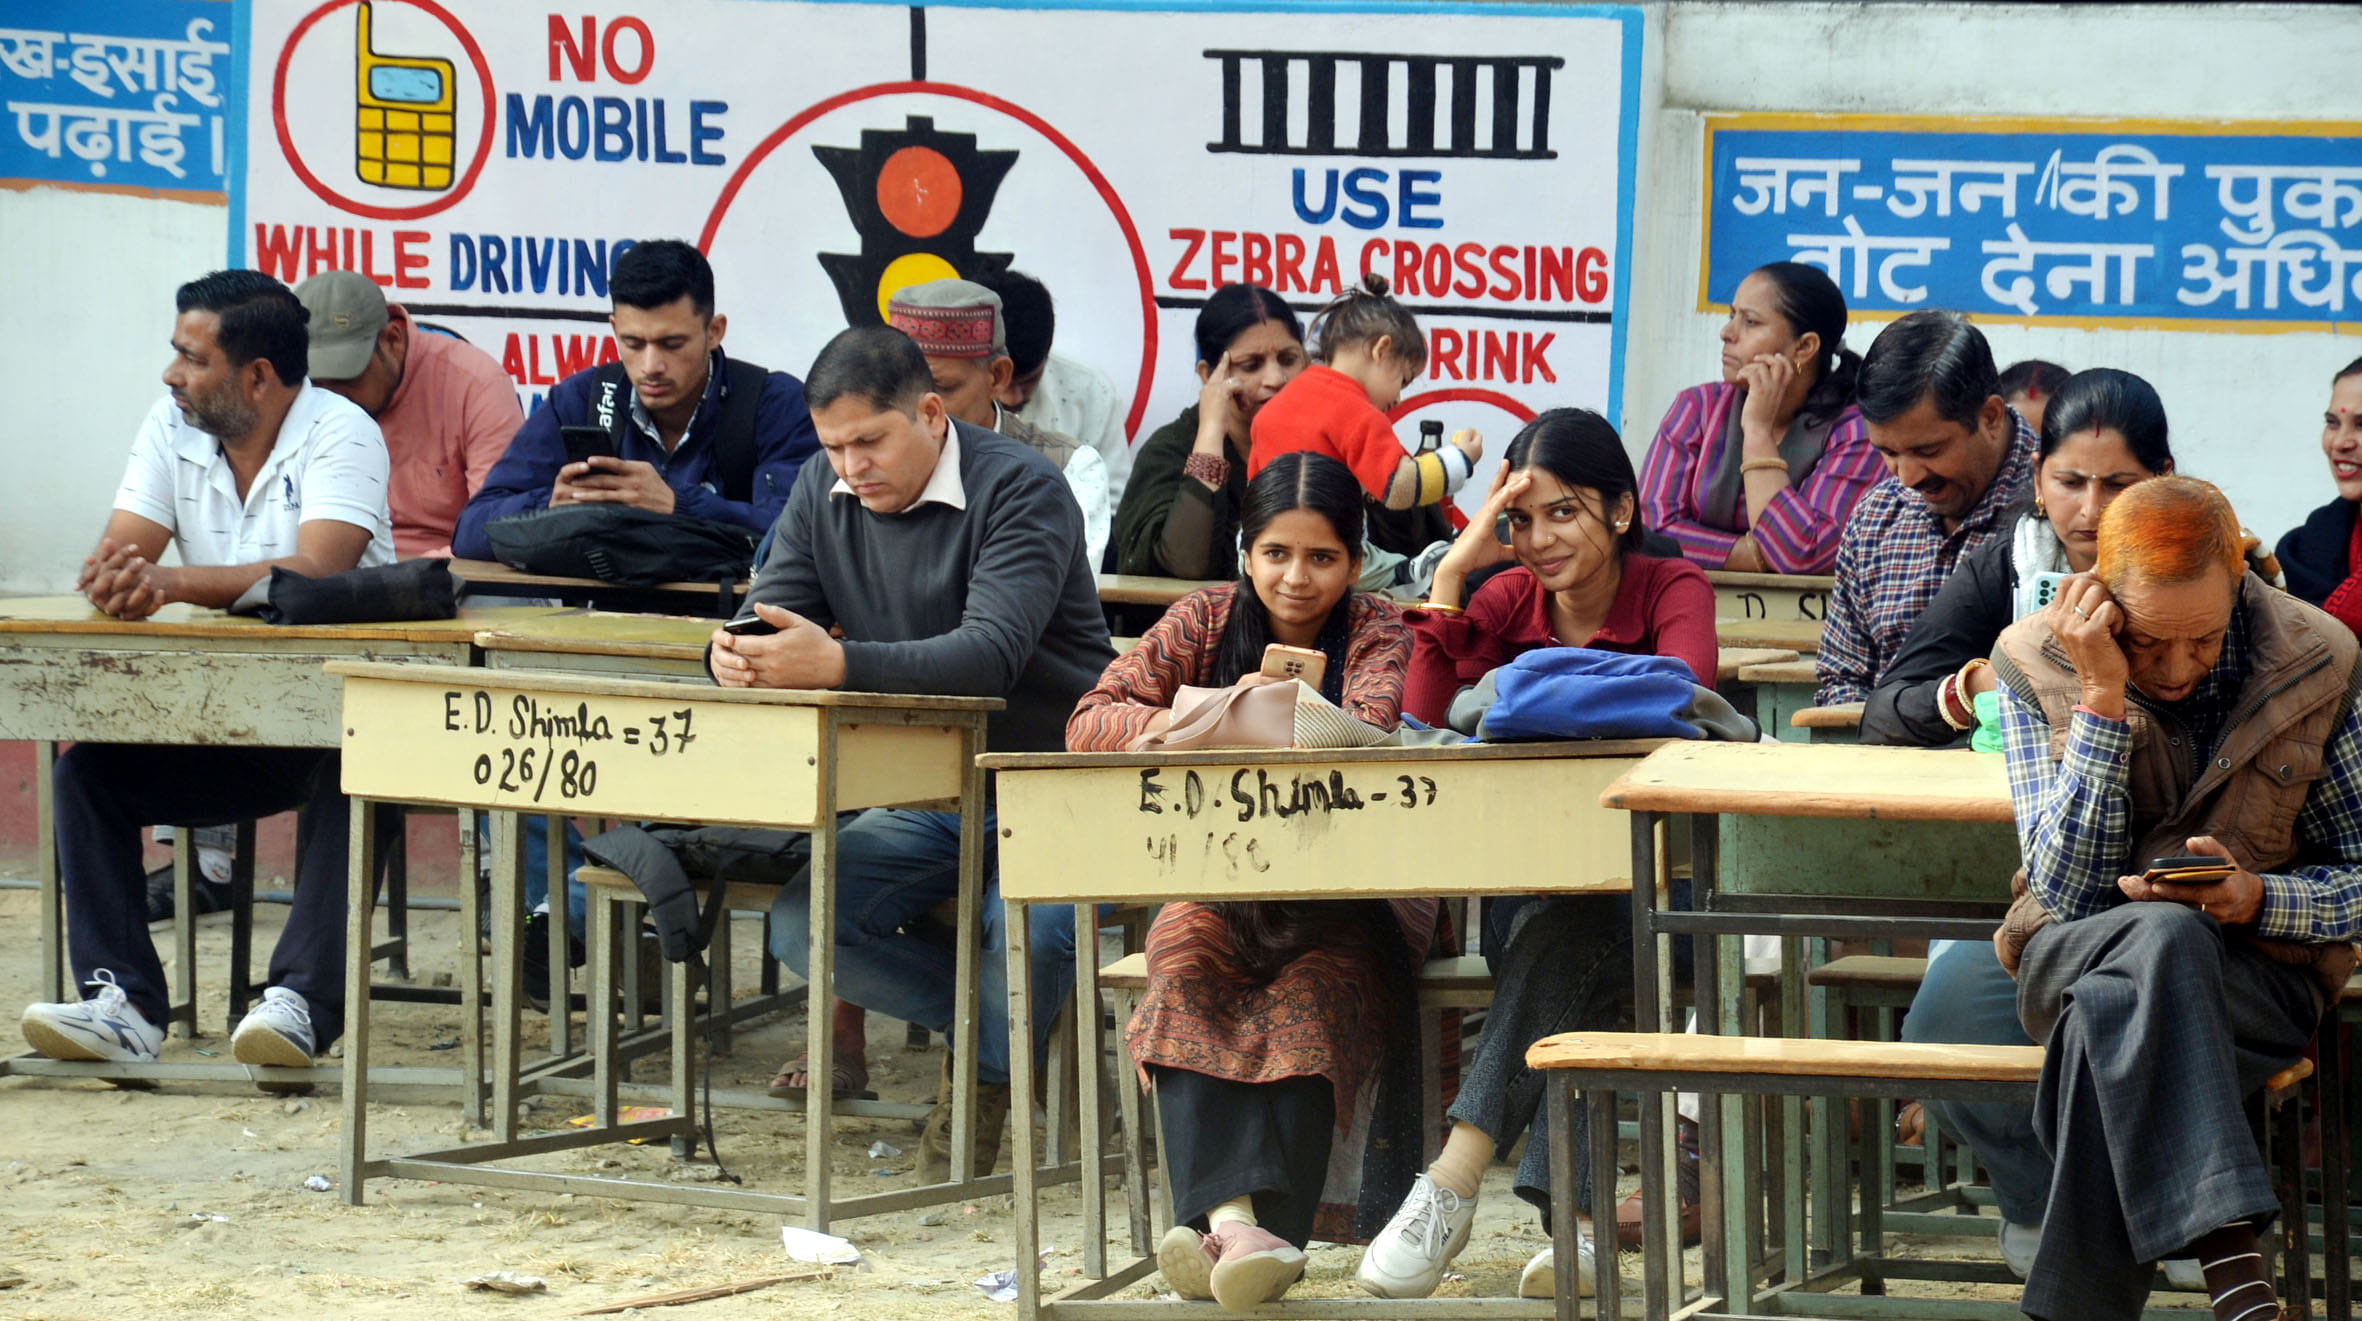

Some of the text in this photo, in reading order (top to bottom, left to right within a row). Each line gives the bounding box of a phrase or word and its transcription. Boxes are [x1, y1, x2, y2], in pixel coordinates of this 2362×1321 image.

[547, 14, 655, 85] NO
[505, 92, 729, 166] MOBILE
[1292, 167, 1445, 230] USE
[1732, 156, 2036, 219] जन-जन
[2058, 143, 2185, 221] की
[255, 222, 432, 289] WHILE
[1168, 228, 1609, 304] ZEBRA CROSSING
[1980, 222, 2155, 317] देना
[2176, 229, 2362, 313] अधि
[1421, 327, 1558, 384] RINK
[596, 381, 617, 433] afari
